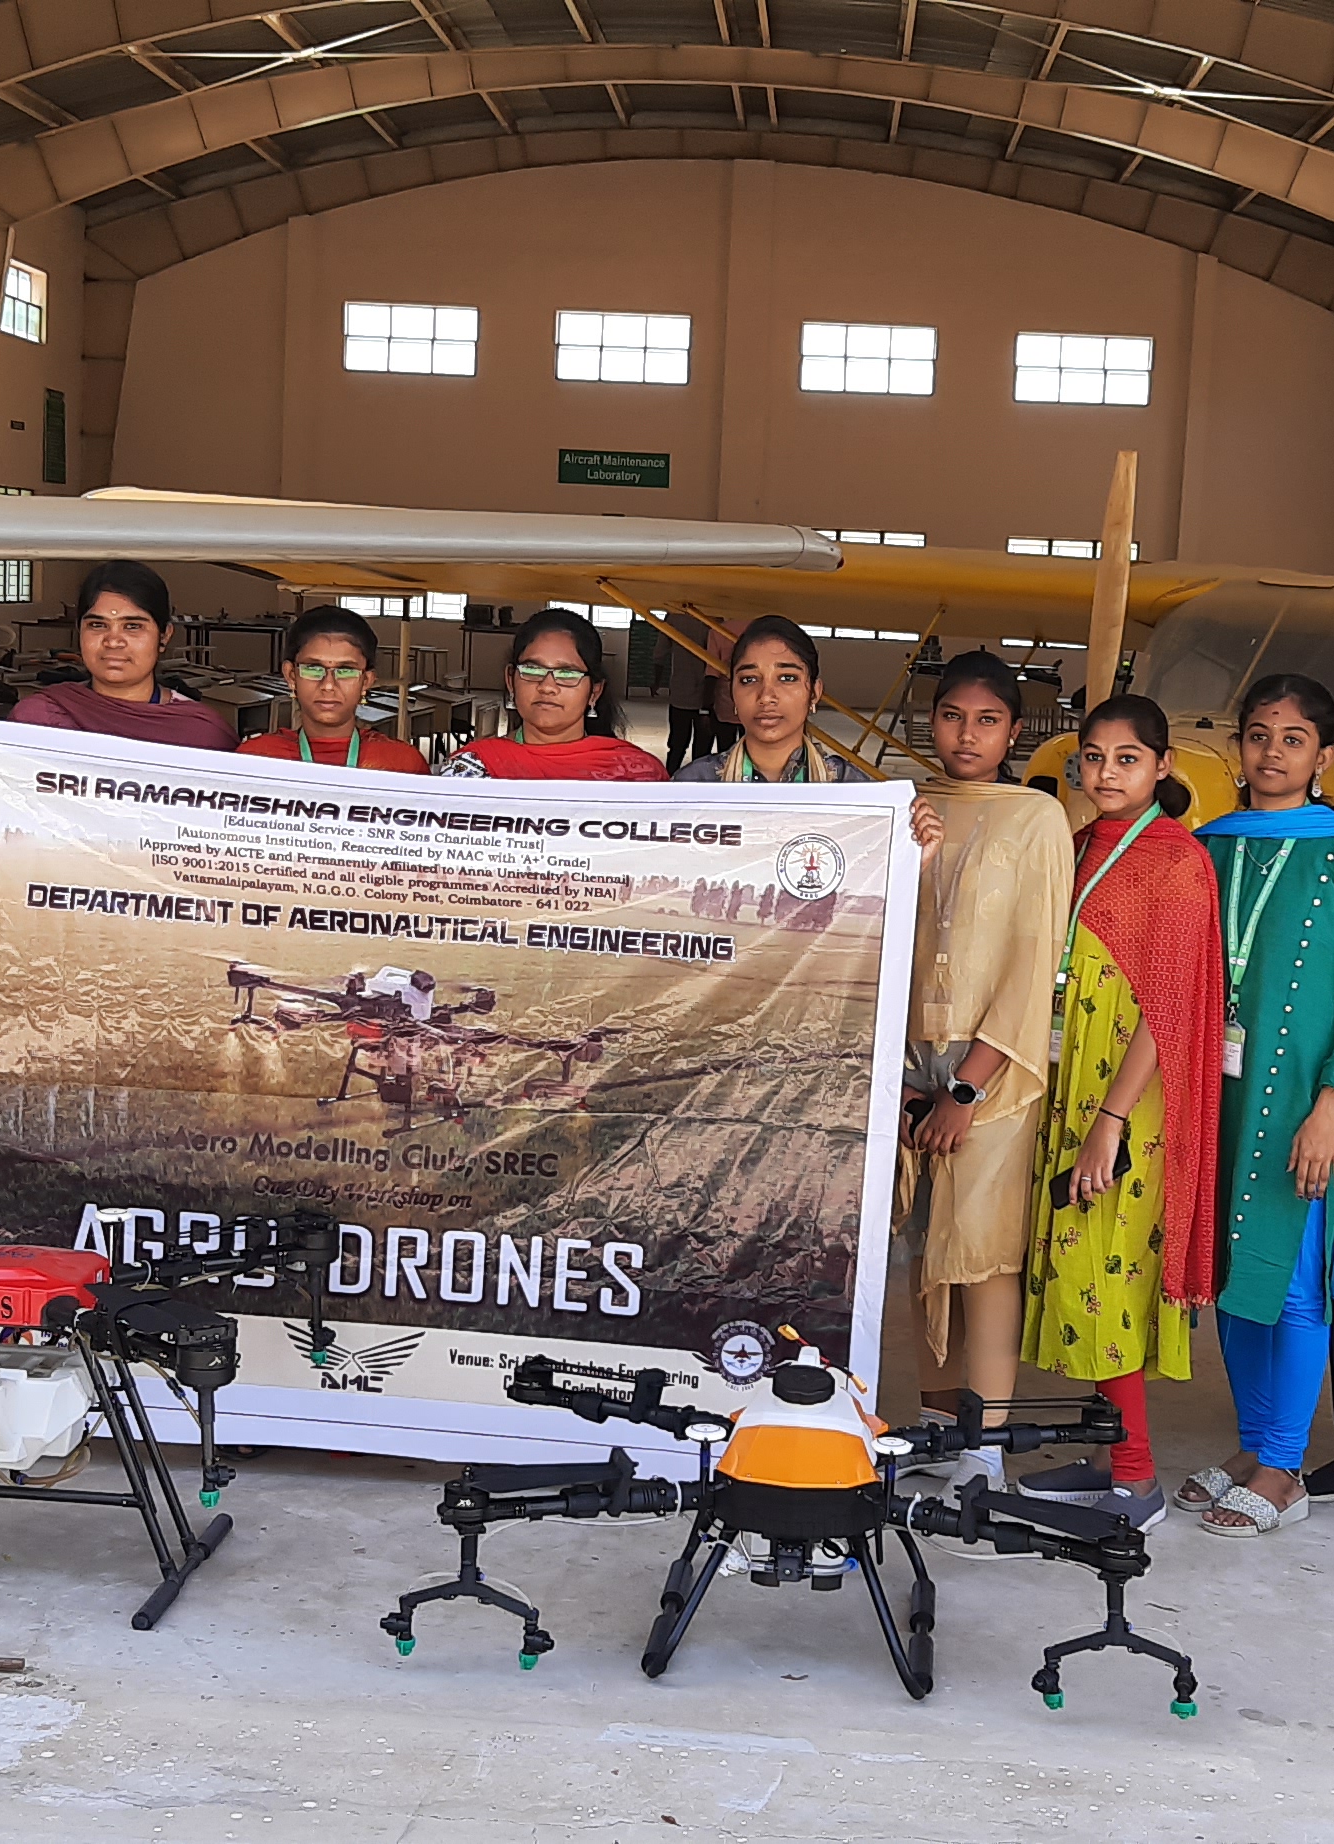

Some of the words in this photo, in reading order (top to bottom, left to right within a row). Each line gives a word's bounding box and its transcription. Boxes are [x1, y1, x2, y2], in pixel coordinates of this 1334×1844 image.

[563, 453, 601, 467] Aircraft
[603, 455, 666, 469] Maintenance
[587, 469, 641, 484] Laboratory
[35, 772, 88, 798] SRI
[95, 777, 340, 821] RAMAKRISHNA
[347, 805, 571, 837] ENGINEERING
[579, 819, 742, 847] COLLEGE
[177, 825, 261, 844] [Autonomous
[266, 834, 338, 853] Institution,
[341, 840, 424, 858] Reaccredited
[427, 847, 444, 861] by
[447, 849, 484, 863] NAAC
[488, 851, 516, 865] with
[547, 855, 591, 870] Grade]
[223, 814, 305, 833] [Educational
[309, 821, 355, 837] Service
[366, 827, 396, 840] SNR
[399, 829, 431, 843] Sons
[434, 832, 503, 848] Charitable
[505, 837, 545, 852] Trust]
[139, 837, 202, 855] [Approved
[206, 843, 221, 858] by
[224, 846, 265, 860] AICTE
[268, 850, 293, 863] and
[297, 852, 376, 871] Permanently
[380, 860, 439, 875] Affiliated
[442, 864, 455, 876] to
[458, 865, 494, 879] Anna
[570, 871, 630, 888] Chennai]
[151, 852, 179, 869] [ISO
[182, 856, 250, 874] 9001:2015
[253, 862, 308, 879] Certified
[311, 868, 335, 881] and
[339, 871, 355, 883] all
[359, 873, 404, 888] eligible
[408, 876, 489, 894] programmes
[492, 881, 561, 897] Accredited
[564, 884, 580, 899] by
[583, 886, 617, 901] NBA]
[302, 882, 361, 898] N.G.G.O.
[364, 887, 409, 904] Colony
[412, 891, 444, 906] Post,
[447, 893, 523, 909] Coimbatore
[535, 898, 559, 911] 641
[26, 883, 234, 925] DEPARTMENT
[242, 901, 283, 928] OF
[287, 906, 519, 947] AERONAUTICAL
[526, 922, 736, 961] ENGINEERING
[167, 1126, 238, 1155] Aero
[248, 1132, 390, 1172] Modelling
[401, 1143, 474, 1176] Club,
[484, 1150, 559, 1178] SREC
[253, 1175, 292, 1197] One
[296, 1177, 340, 1206] Day
[343, 1183, 444, 1214] Workshop
[448, 1193, 473, 1209] on
[328, 1223, 645, 1318] DRONES
[449, 1348, 495, 1369] Venue:
[499, 1353, 519, 1370] Sri
